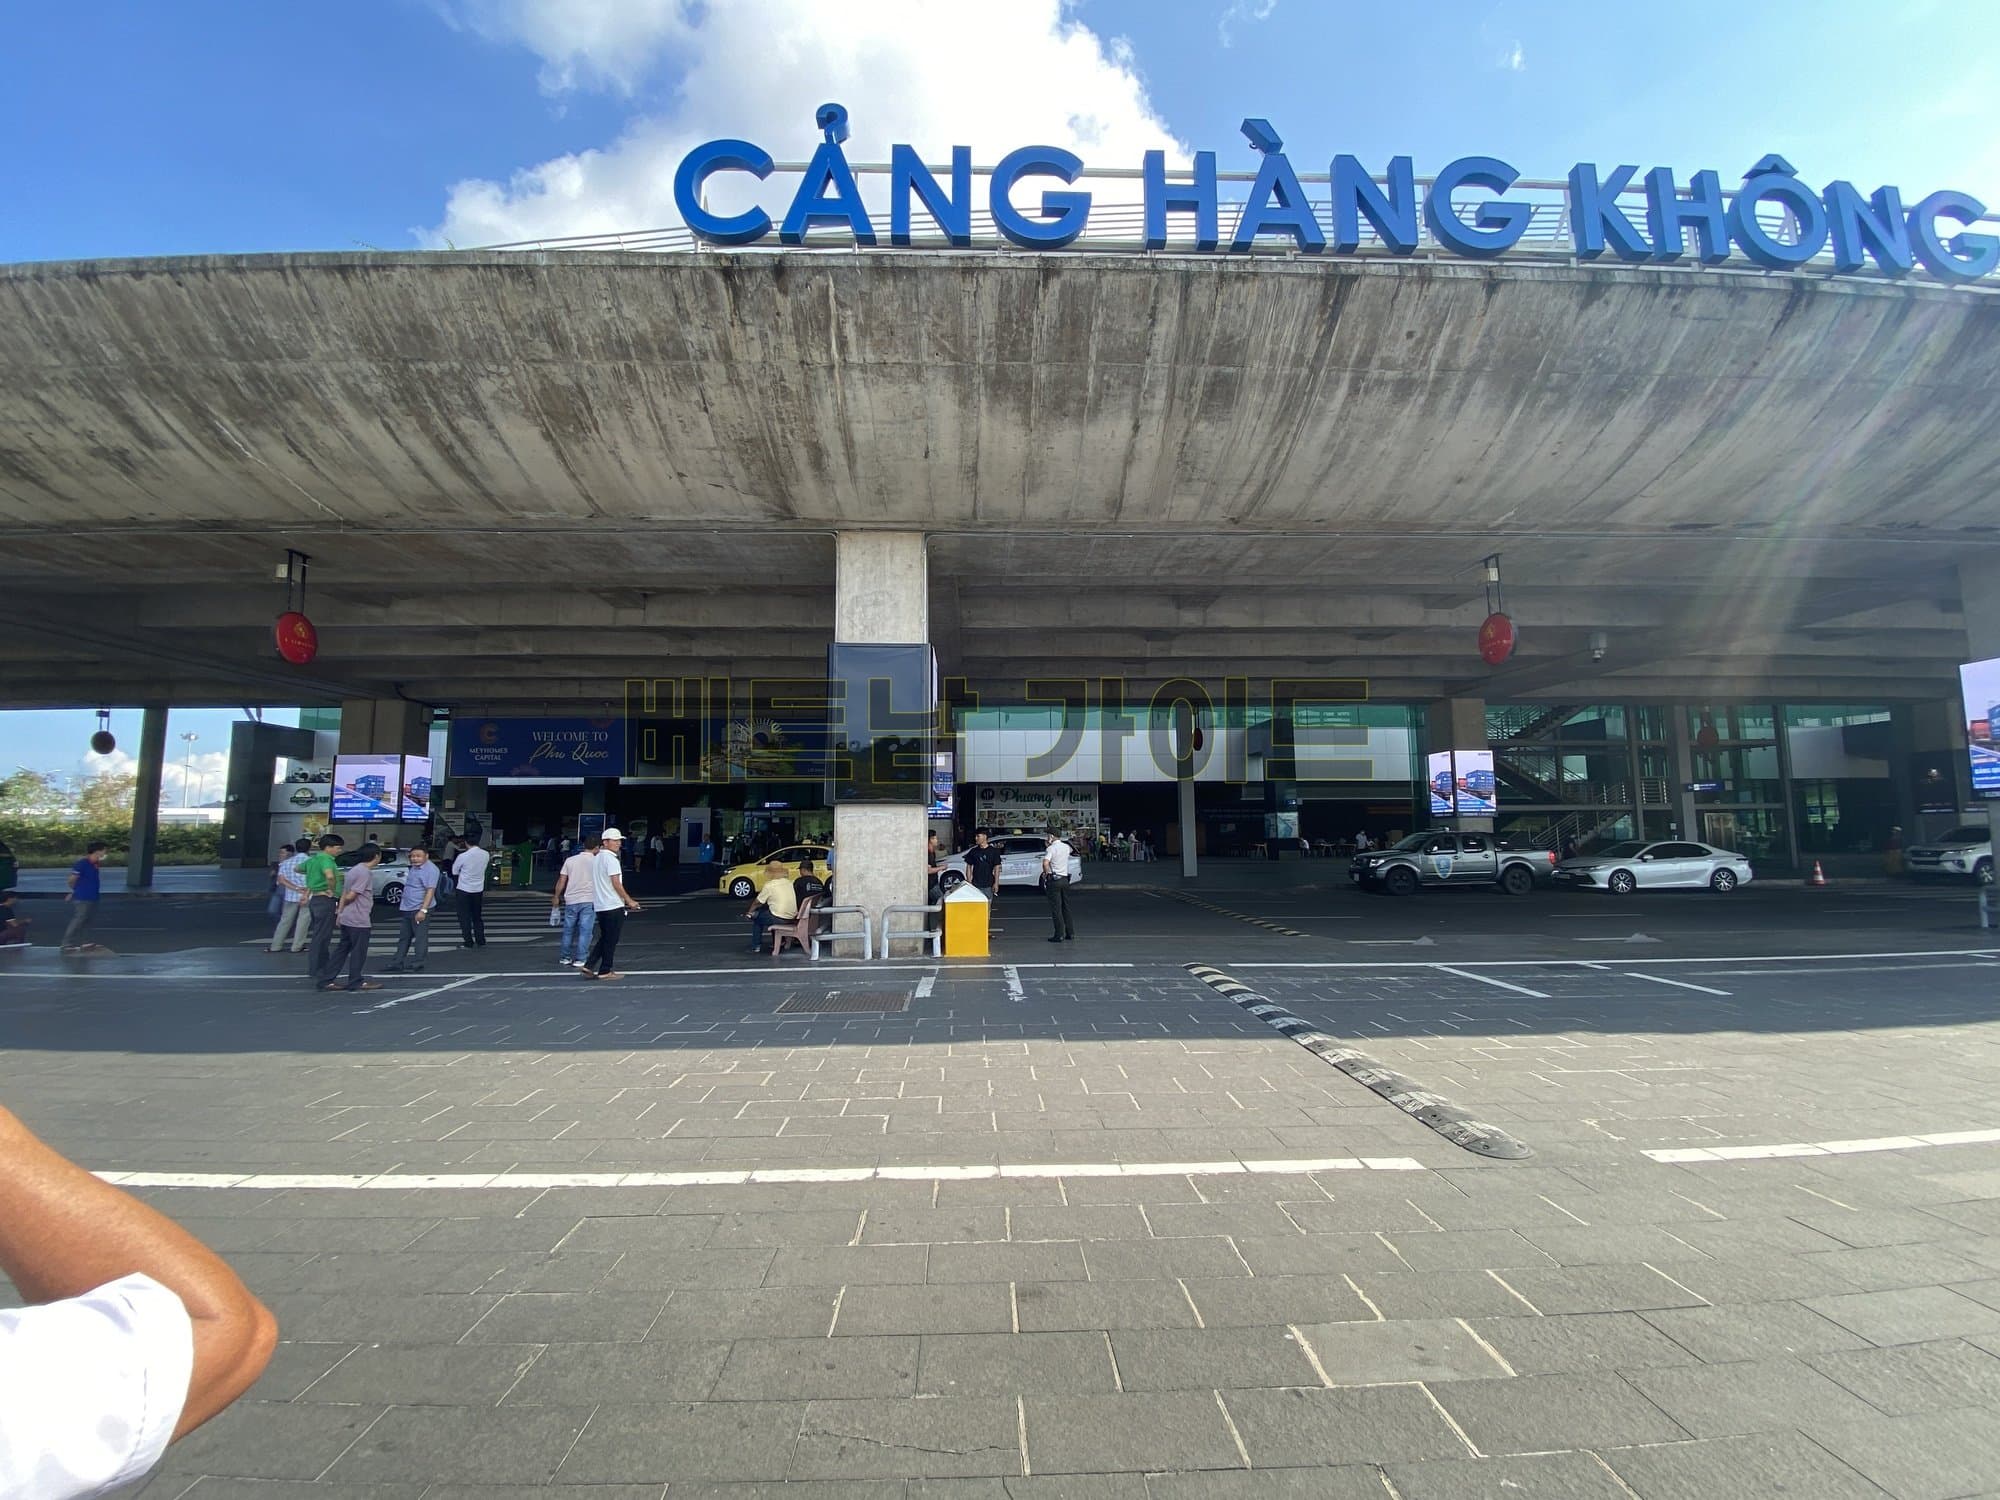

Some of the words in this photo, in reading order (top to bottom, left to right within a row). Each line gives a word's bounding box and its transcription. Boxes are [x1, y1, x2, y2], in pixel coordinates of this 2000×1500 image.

[674, 103, 1091, 250] CẢNG
[1143, 118, 1531, 258] HÀNG
[1568, 153, 2000, 285] KHÔNG
[532, 731, 588, 742] WELCOME
[592, 731, 608, 742] TO
[1057, 787, 1094, 805] Nam
